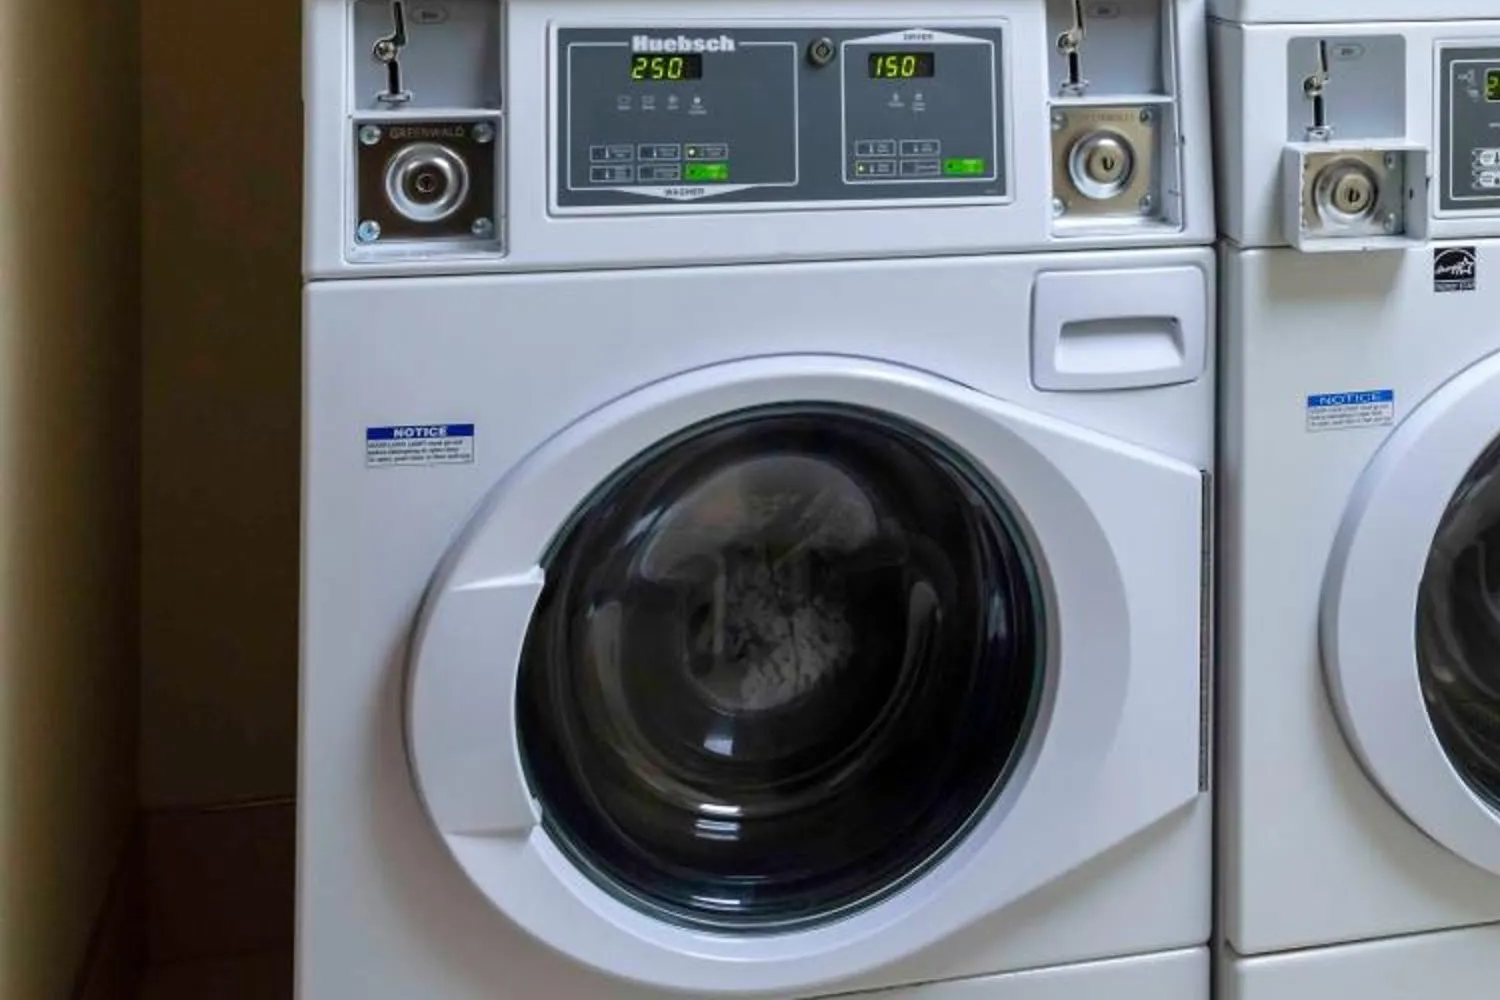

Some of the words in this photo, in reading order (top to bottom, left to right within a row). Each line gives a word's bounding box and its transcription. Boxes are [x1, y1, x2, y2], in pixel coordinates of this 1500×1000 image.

[631, 35, 736, 52] Huebsch
[631, 56, 684, 79] 250
[874, 55, 916, 78] 150
[1319, 393, 1381, 405] NOTICE
[393, 427, 447, 438] NOTICE
